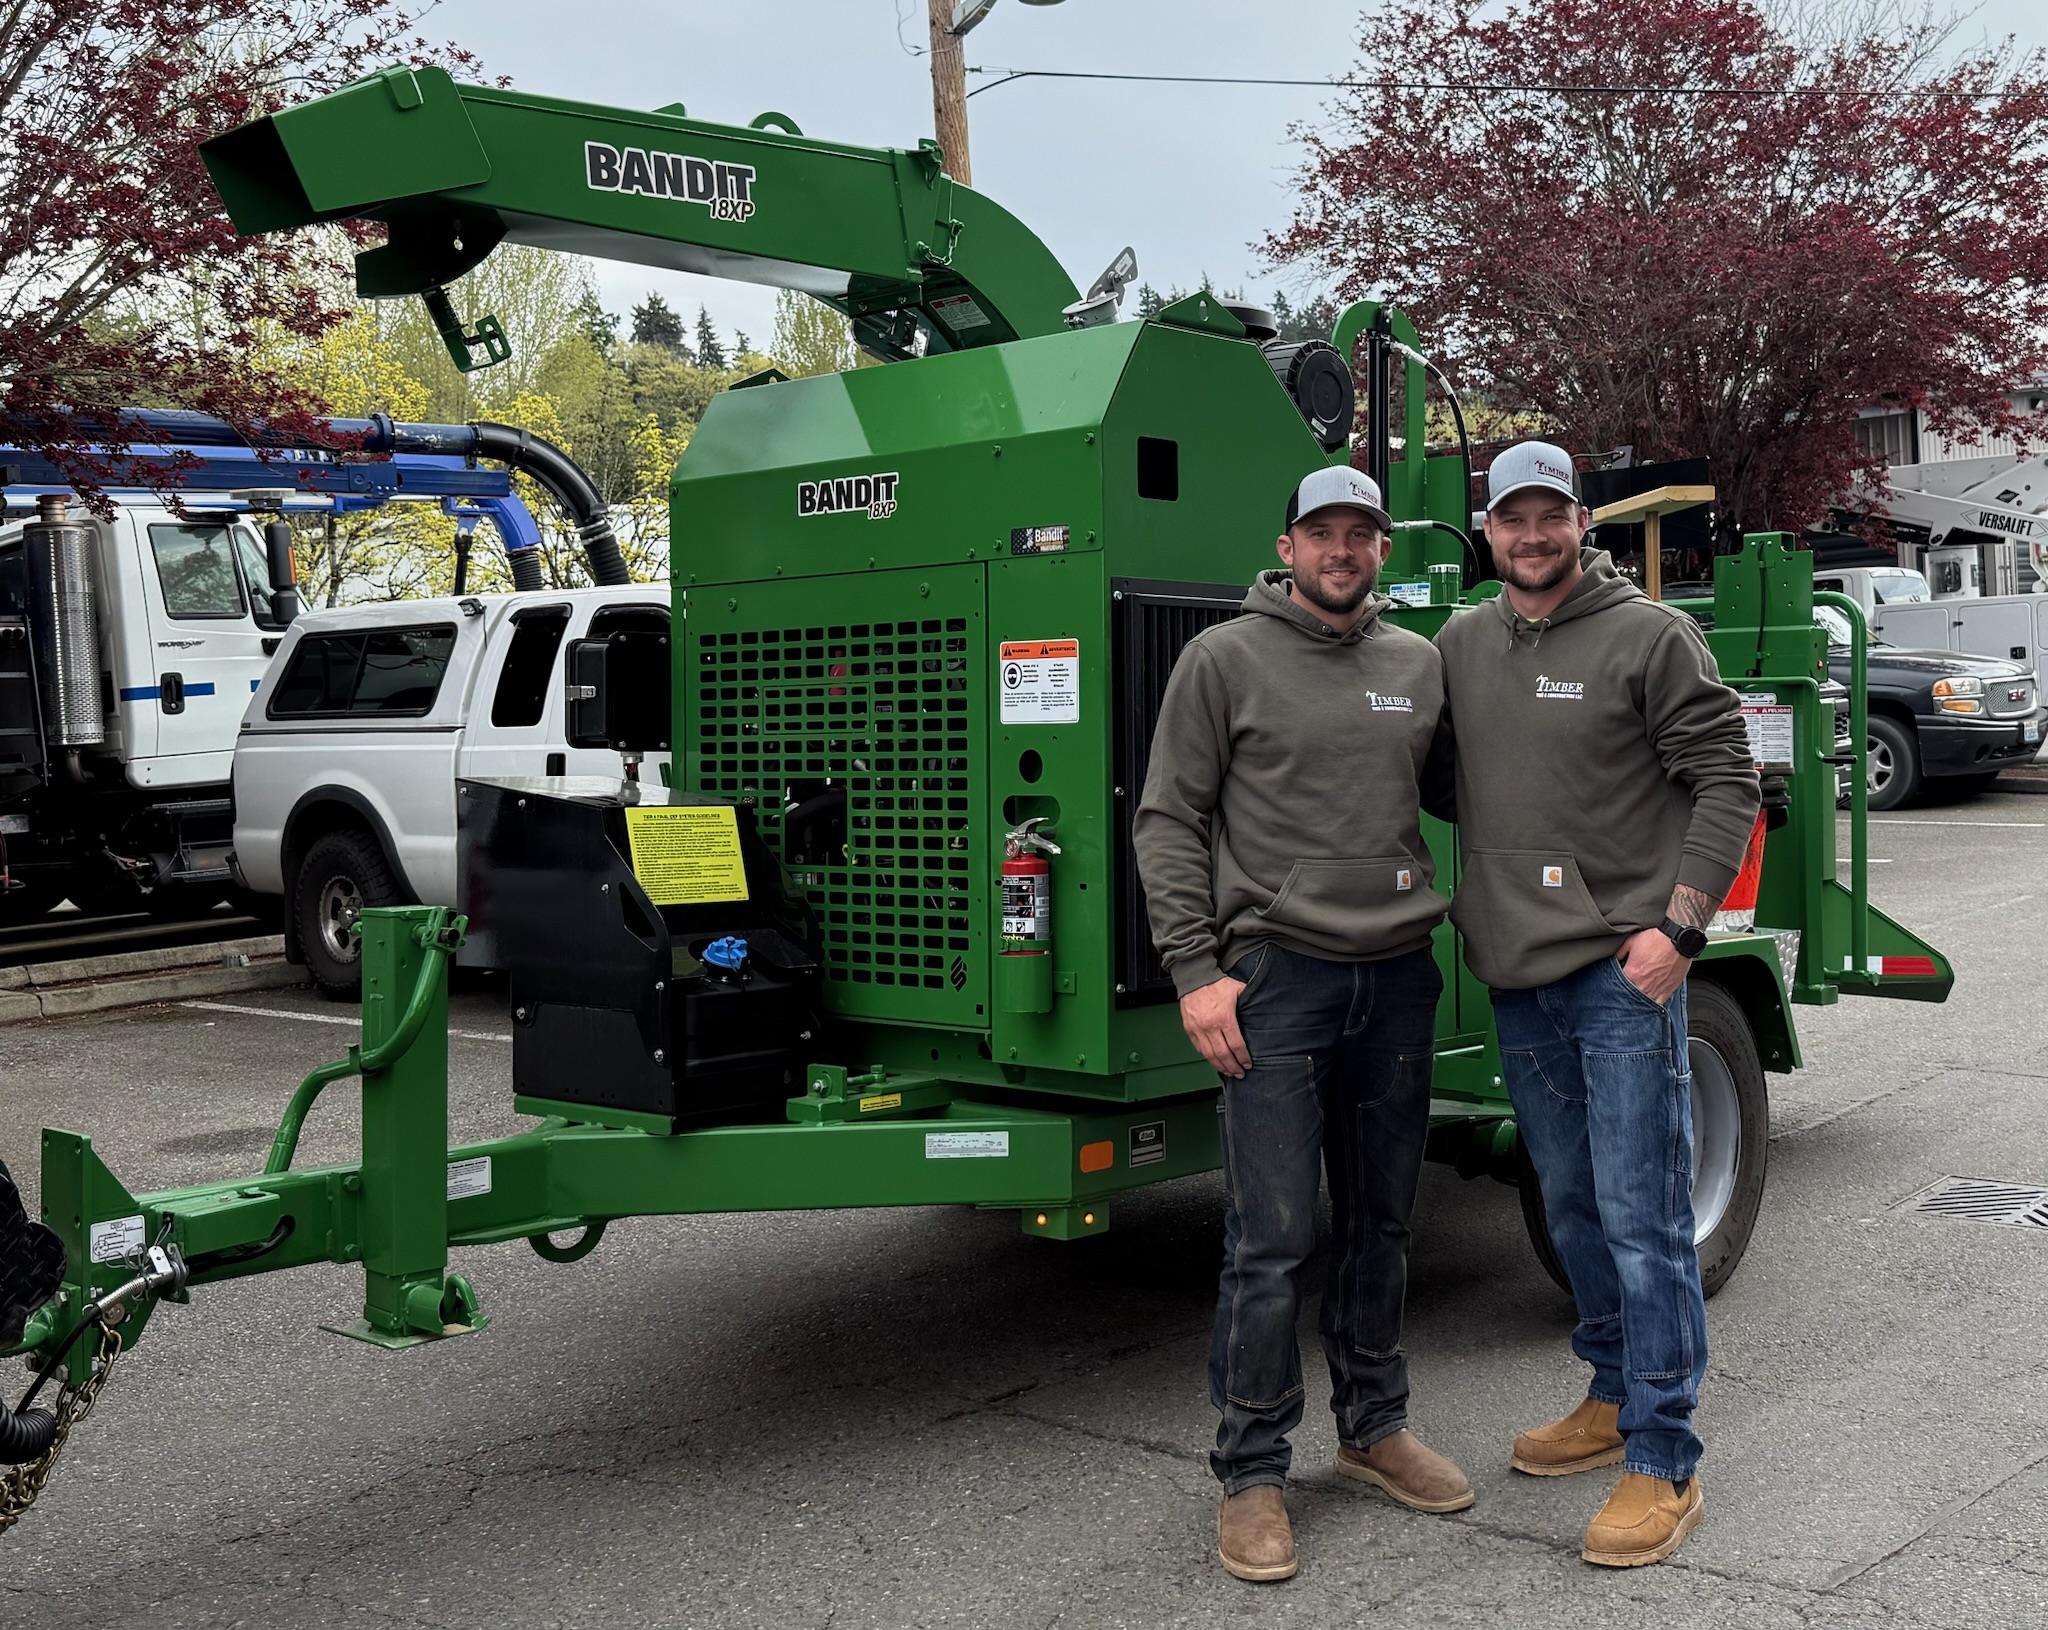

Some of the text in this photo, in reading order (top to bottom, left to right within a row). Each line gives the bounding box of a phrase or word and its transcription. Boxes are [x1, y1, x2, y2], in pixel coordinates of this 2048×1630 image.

[586, 142, 756, 203] BANDIT
[711, 199, 755, 221] 18XP
[799, 473, 899, 515] BANDIT
[868, 501, 896, 519] 18XP
[1979, 511, 2035, 536] VERSALIFT
[1035, 527, 1063, 542] Bandit
[1536, 674, 1584, 693] TIMBER
[1365, 690, 1412, 707] TIMBER
